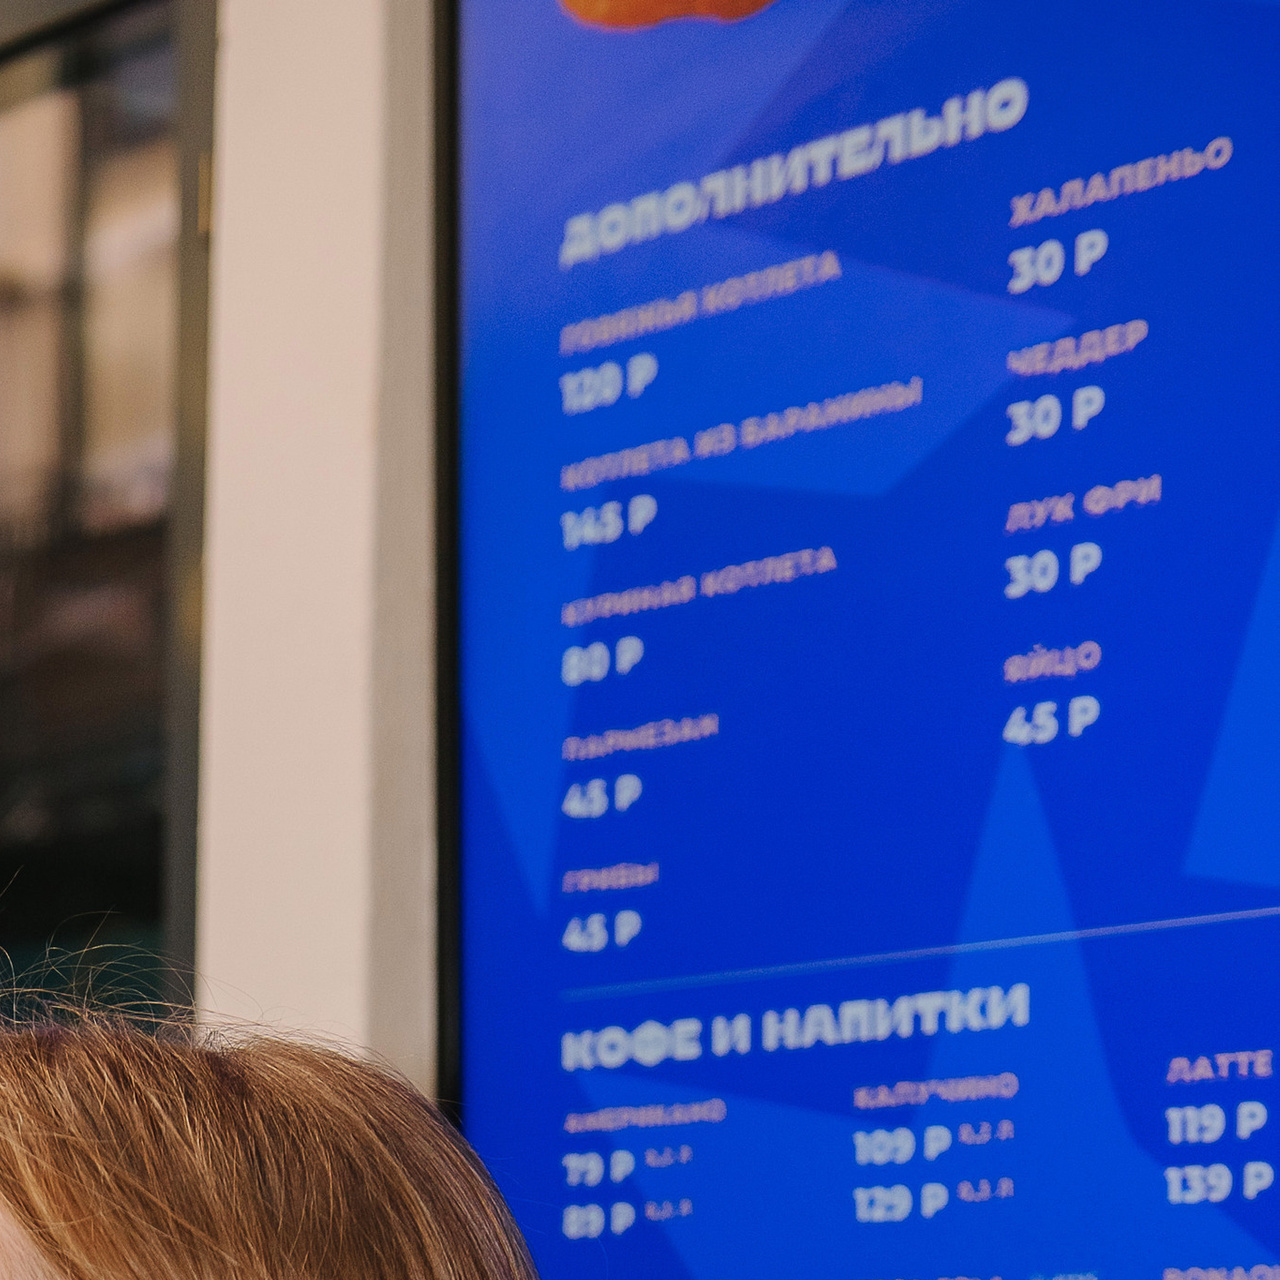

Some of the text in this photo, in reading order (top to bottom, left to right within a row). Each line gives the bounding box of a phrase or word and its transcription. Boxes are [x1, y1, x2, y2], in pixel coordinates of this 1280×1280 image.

[560, 77, 1029, 267] ДОПОЛНИТЕЛЬНО
[1008, 137, 1232, 228] ХАЛАПЕНЬО
[1007, 239, 1065, 294] 30
[1007, 319, 1148, 376] ЧЕДДЕР
[1005, 395, 1062, 446] 30
[1005, 474, 1162, 533] ЛУК ФРИ
[1004, 550, 1059, 599] 30
[1003, 701, 1058, 746] 45
[562, 778, 608, 818] 45
[563, 912, 608, 952] 45
[561, 983, 1030, 1071] КОФЕ И НАПИТКИ
[1166, 1050, 1273, 1083] ЛАТТЕ
[1165, 1104, 1226, 1145] 119
[853, 1184, 913, 1222] 129
[1164, 1164, 1232, 1204] 139
